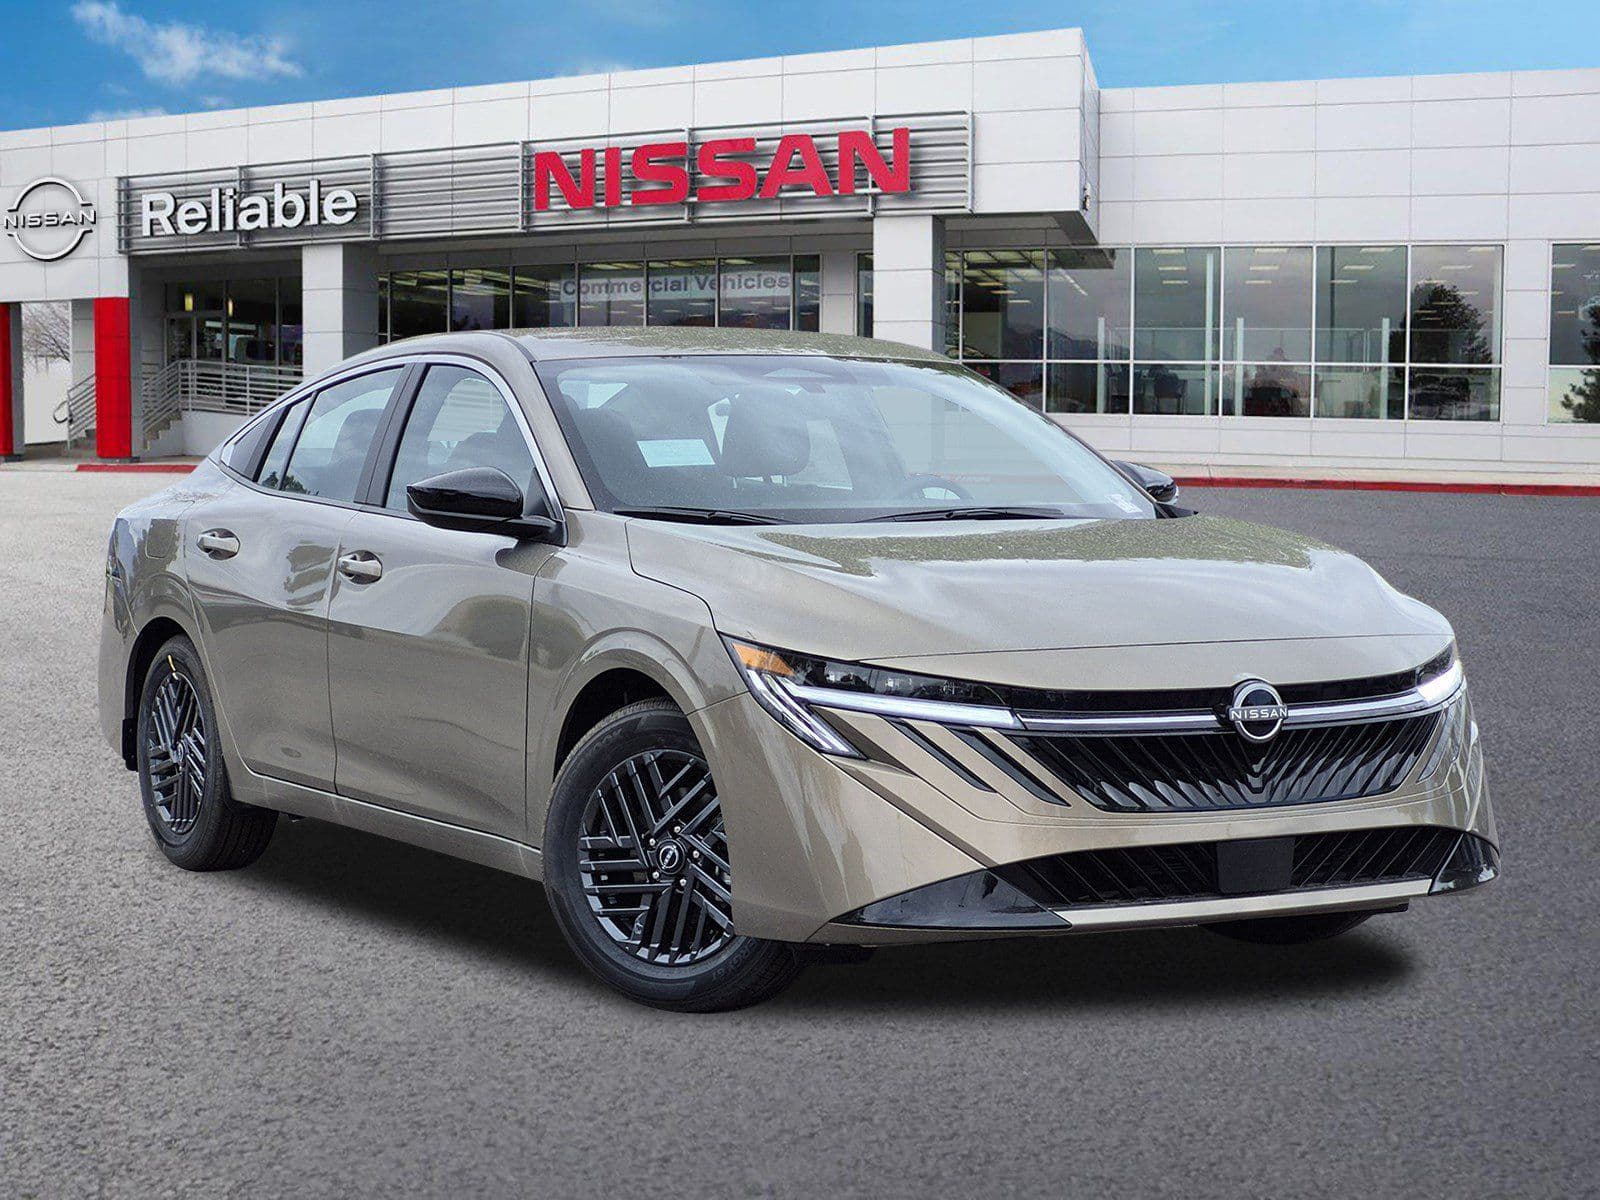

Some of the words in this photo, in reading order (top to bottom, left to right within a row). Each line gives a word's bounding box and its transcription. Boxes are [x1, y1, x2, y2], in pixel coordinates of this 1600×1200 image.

[534, 128, 911, 211] NISSAN
[3, 209, 96, 229] NISSAN
[141, 179, 357, 236] Reliable
[562, 276, 688, 296] Commecial
[694, 272, 790, 290] Vehicles
[1231, 707, 1287, 719] NISSAN
